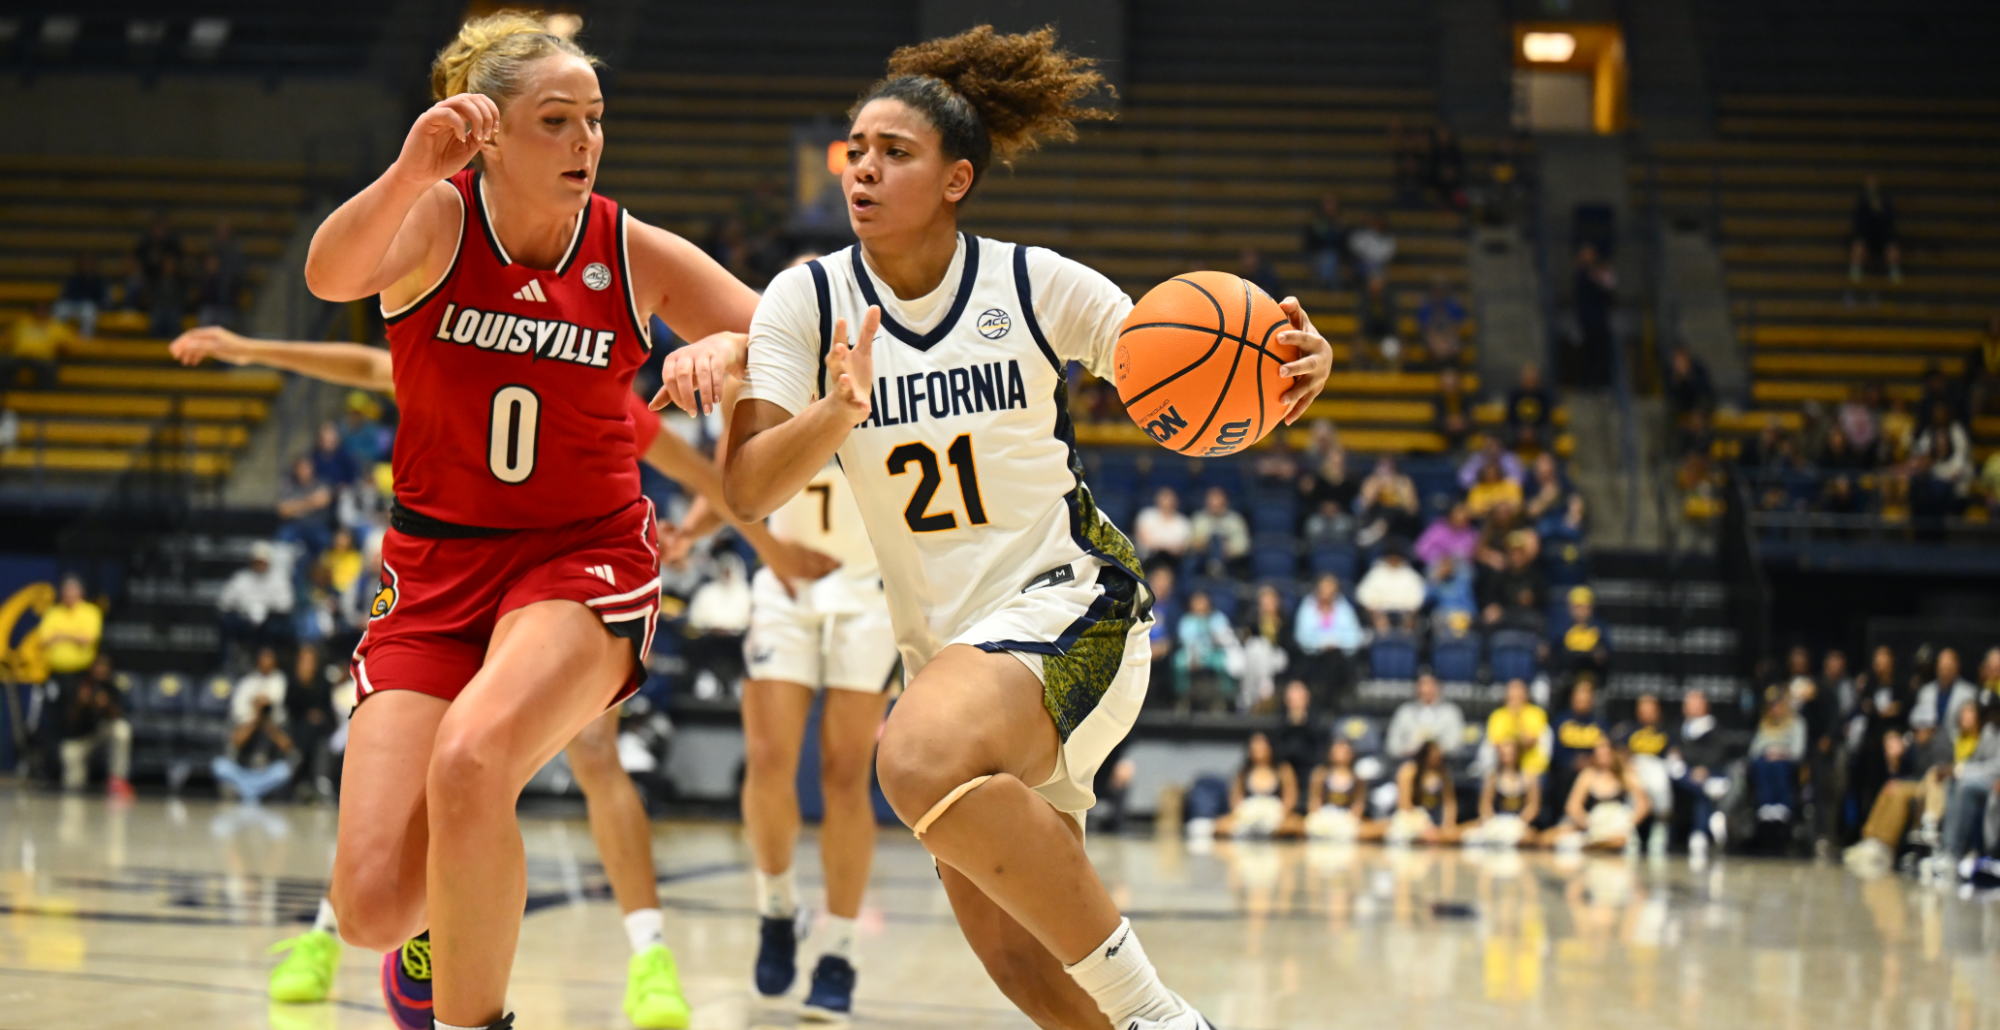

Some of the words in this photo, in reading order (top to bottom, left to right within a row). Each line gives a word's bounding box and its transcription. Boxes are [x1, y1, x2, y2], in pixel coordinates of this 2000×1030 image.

[435, 303, 616, 368] LOUISVILLE
[853, 359, 1028, 428] ALIFORNIA
[1141, 405, 1189, 443] NCA
[488, 384, 541, 485] 0
[804, 483, 832, 534] 7
[885, 432, 990, 533] 21
[1055, 568, 1066, 578] M
